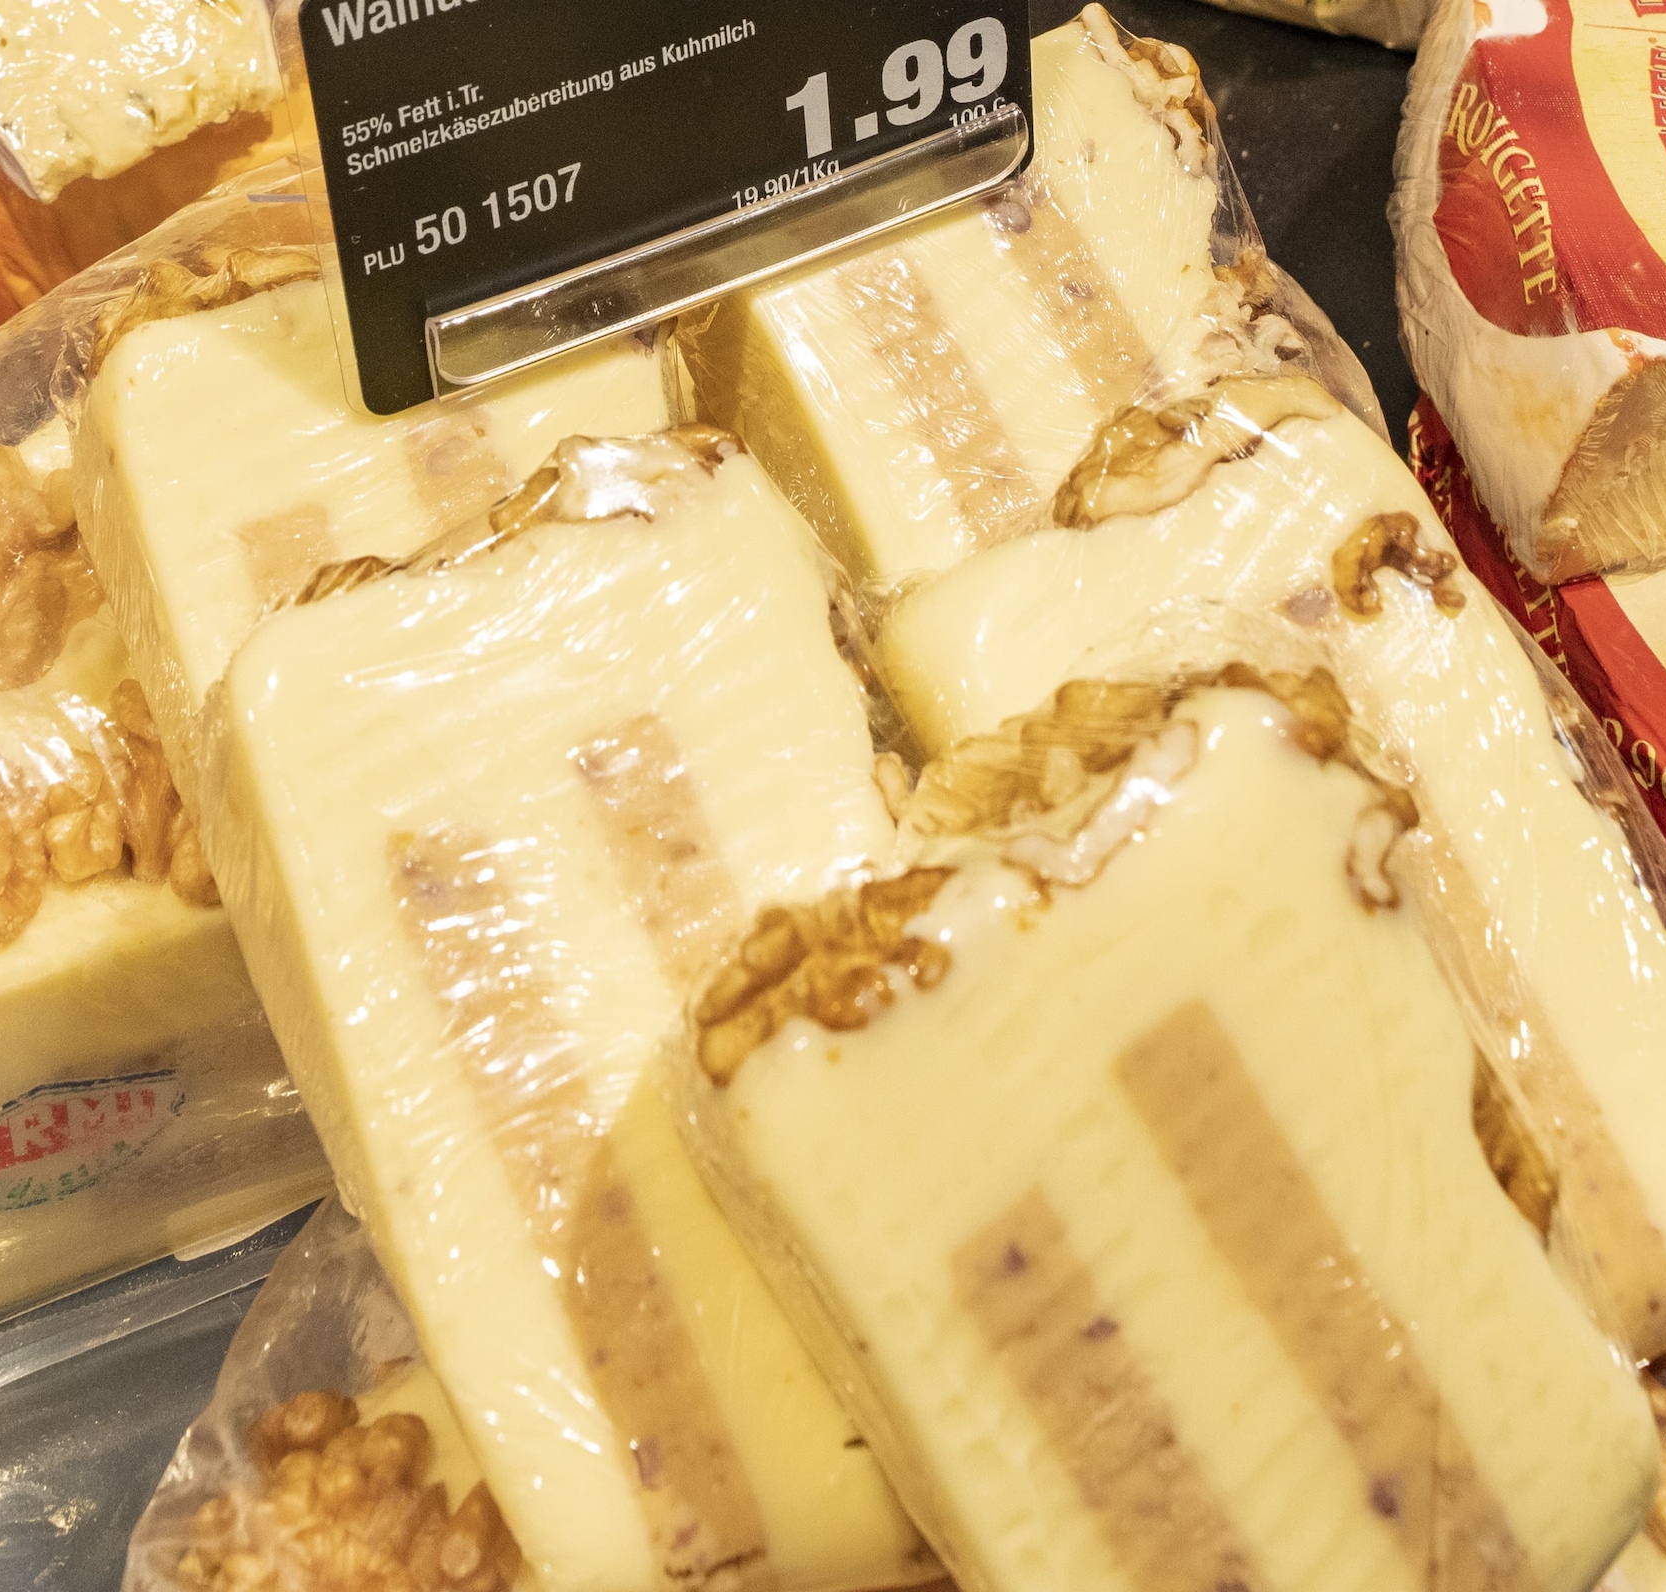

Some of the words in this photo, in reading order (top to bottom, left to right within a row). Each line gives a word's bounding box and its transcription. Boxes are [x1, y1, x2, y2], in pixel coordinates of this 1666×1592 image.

[341, 114, 393, 148] 55%
[398, 97, 443, 129] Fett
[346, 67, 615, 177] Schmelzkäsezubereitung
[618, 54, 657, 84] aus
[661, 18, 756, 67] Kuhmilch
[786, 16, 1009, 159] 1.99
[363, 243, 406, 276] PLU
[415, 205, 468, 256] 50
[482, 162, 584, 230] 1507
[1445, 83, 1558, 306] ROUGETTE
